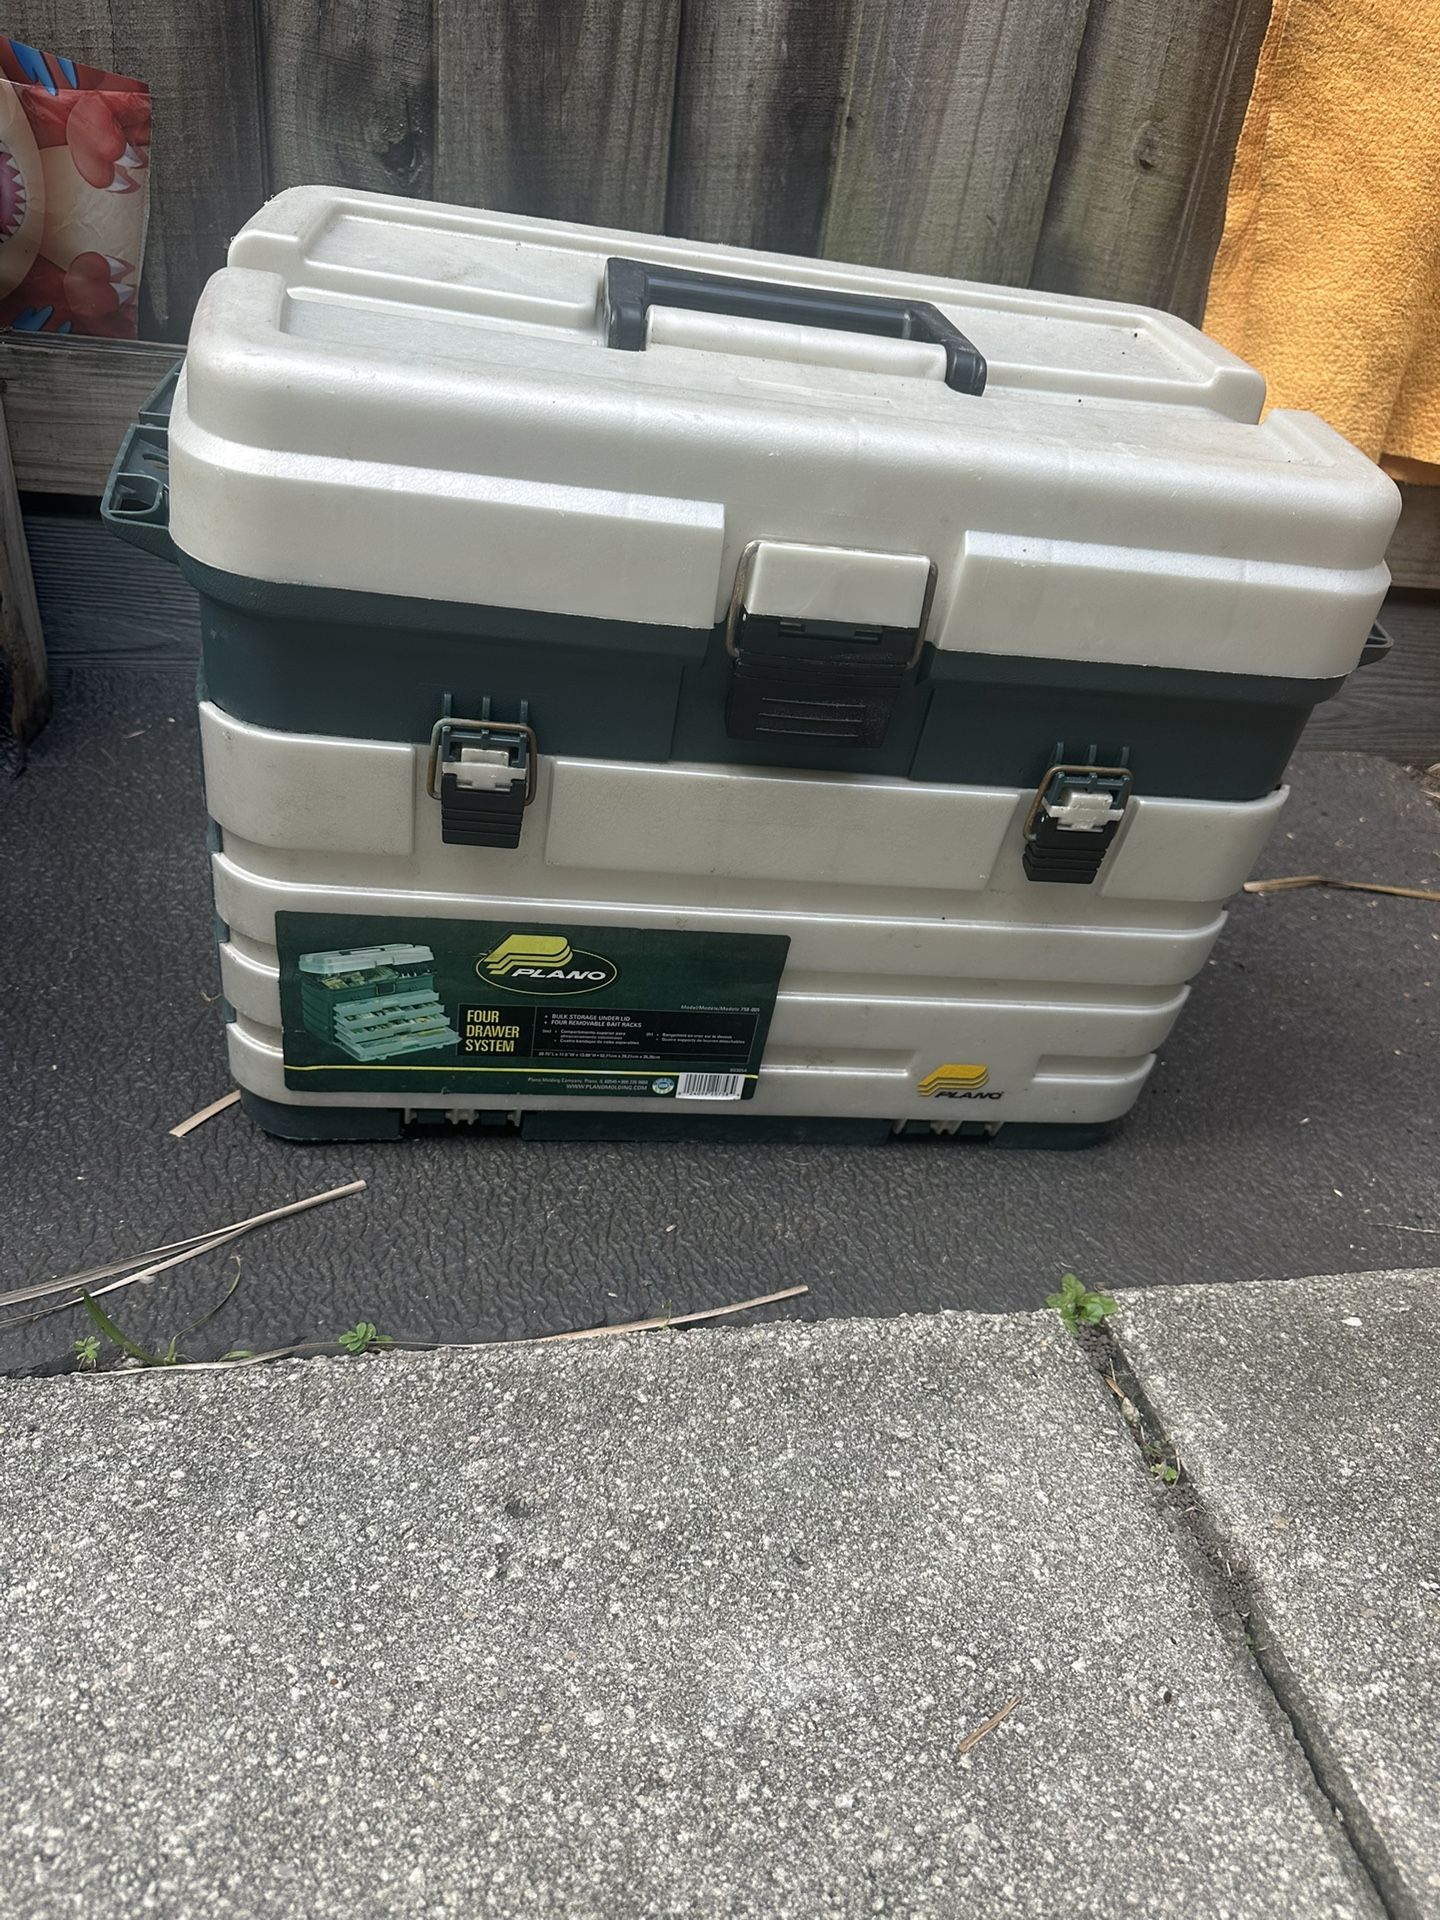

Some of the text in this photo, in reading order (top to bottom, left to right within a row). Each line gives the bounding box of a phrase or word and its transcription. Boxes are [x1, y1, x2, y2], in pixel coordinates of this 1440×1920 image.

[511, 967, 607, 981] PLANO
[467, 1009, 500, 1023] FOUR
[466, 1024, 520, 1038] DRAWER
[465, 1039, 515, 1052] SYSTEM
[934, 1091, 1003, 1100] PLANO
